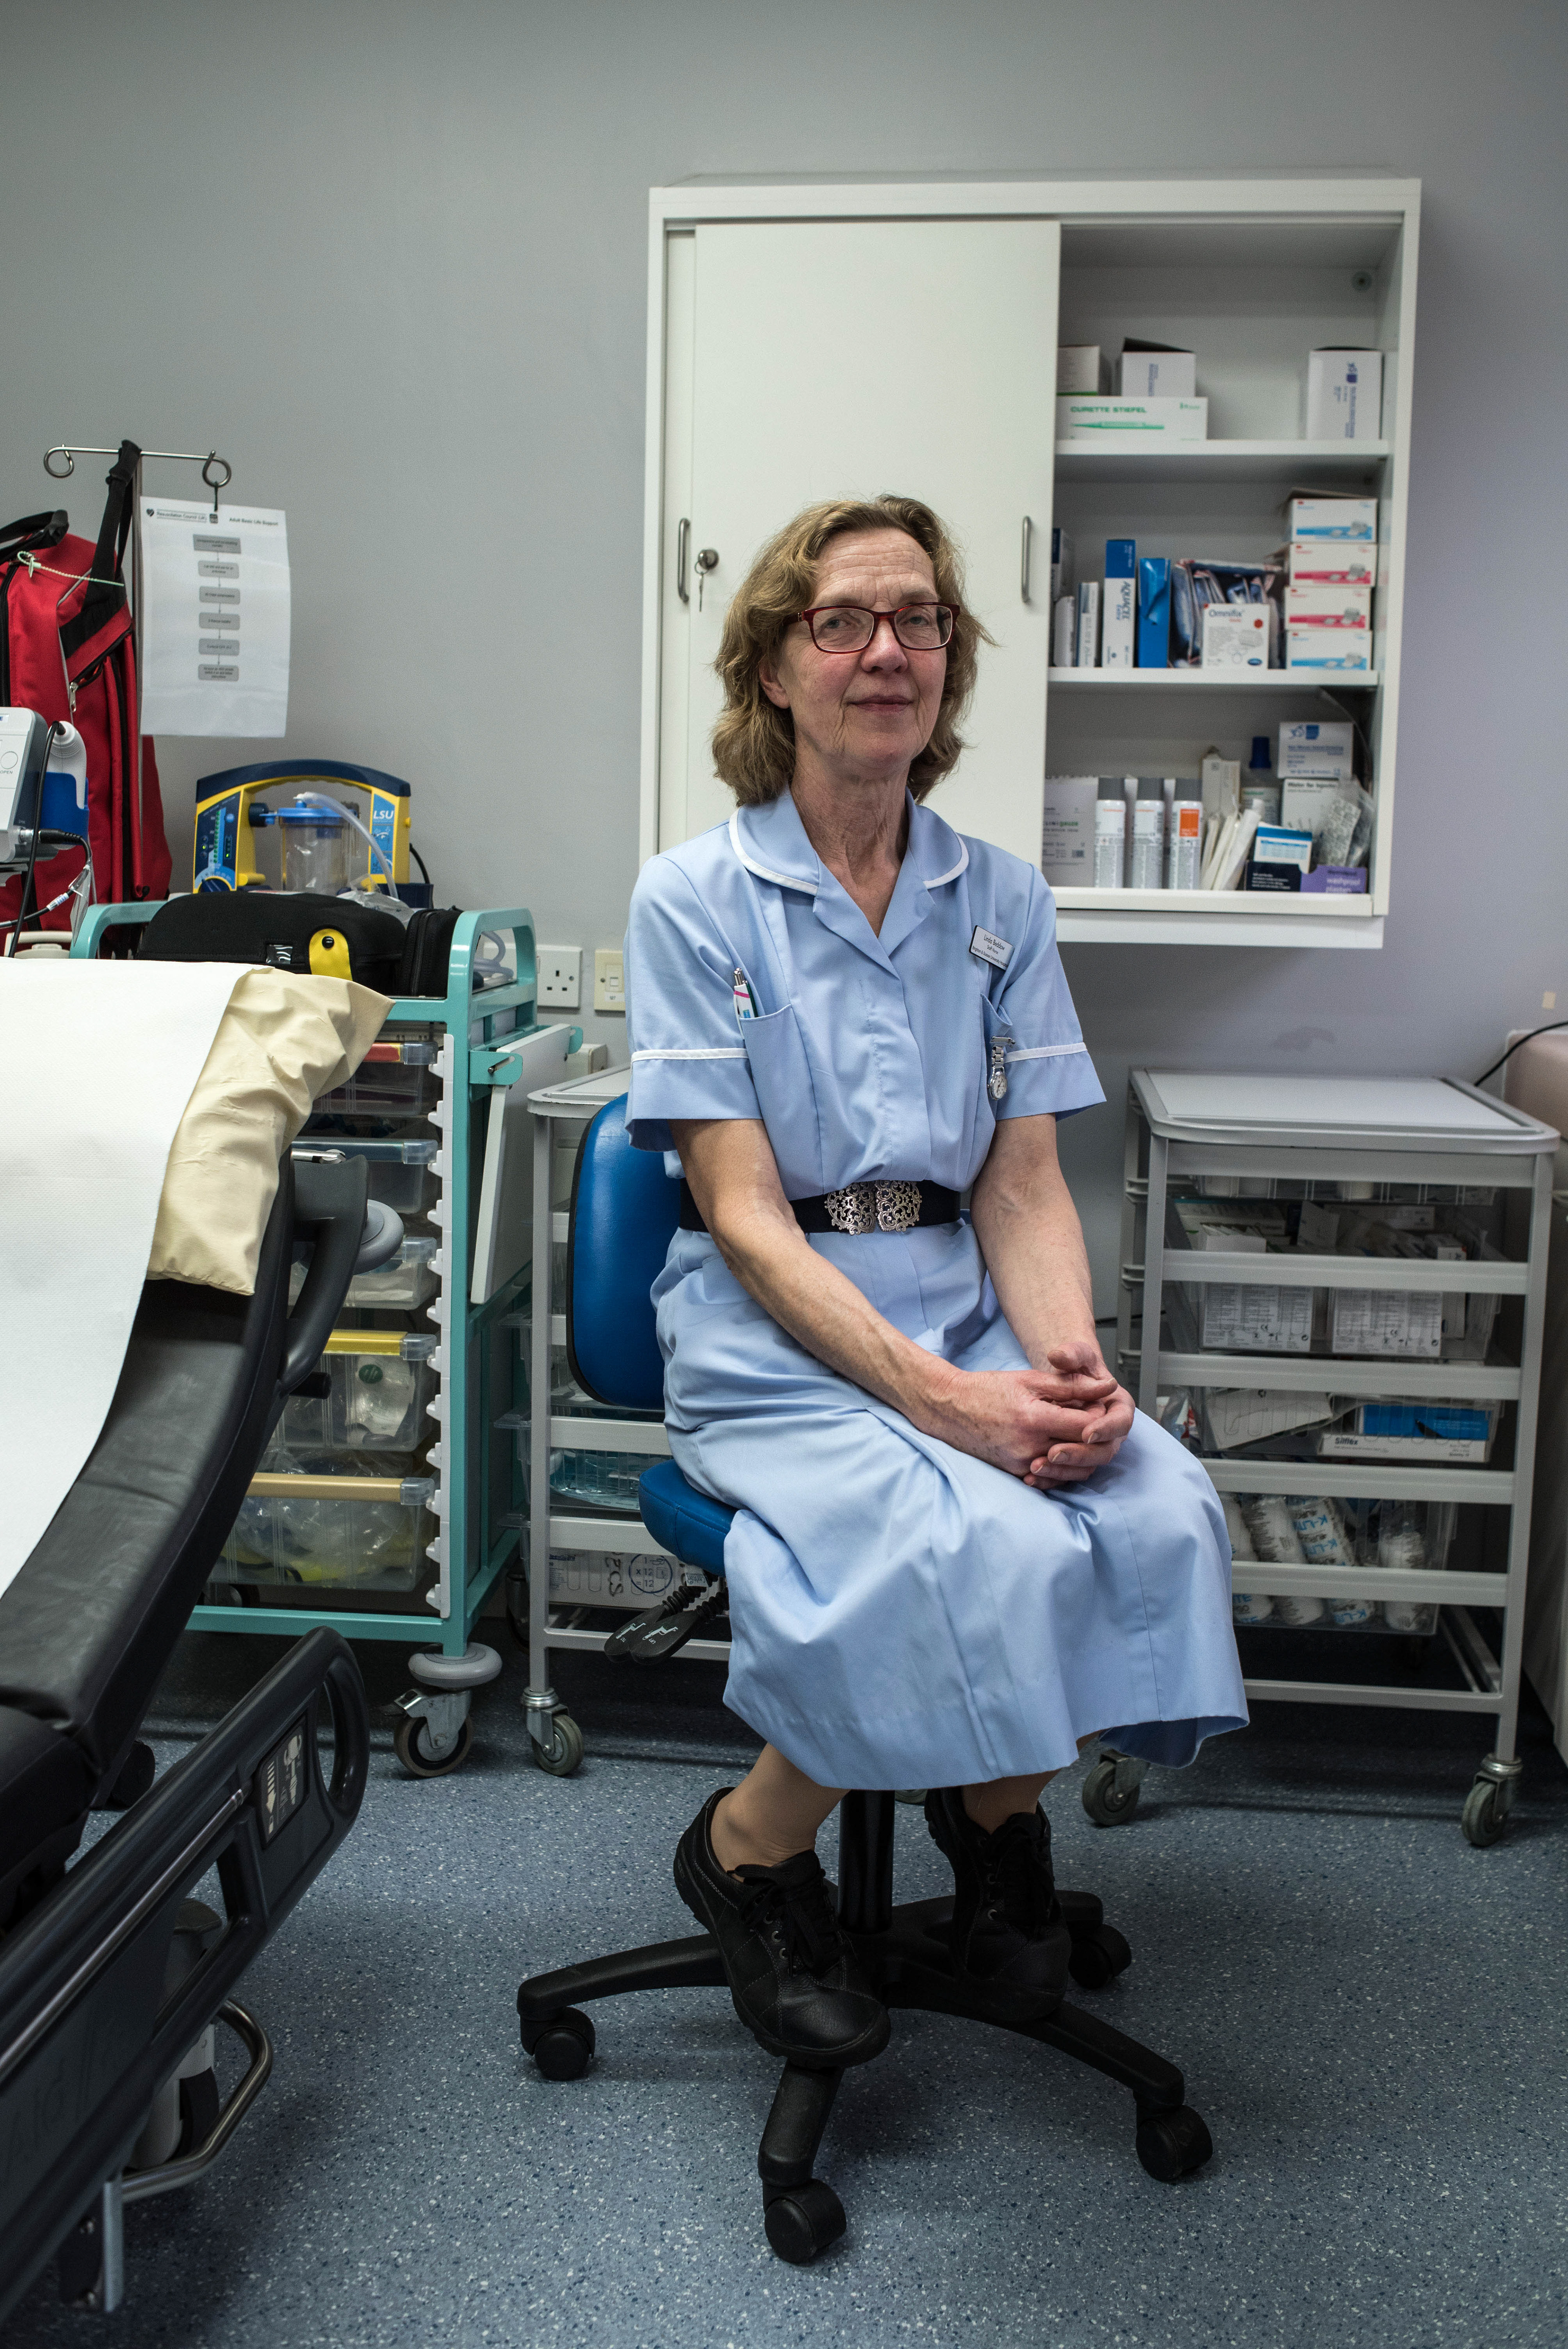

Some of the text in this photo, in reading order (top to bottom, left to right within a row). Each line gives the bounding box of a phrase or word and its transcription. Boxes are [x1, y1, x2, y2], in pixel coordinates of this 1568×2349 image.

[373, 810, 394, 820] LSU
[984, 934, 1005, 951] Linda Beddow
[1335, 1437, 1358, 1446] Silflex
